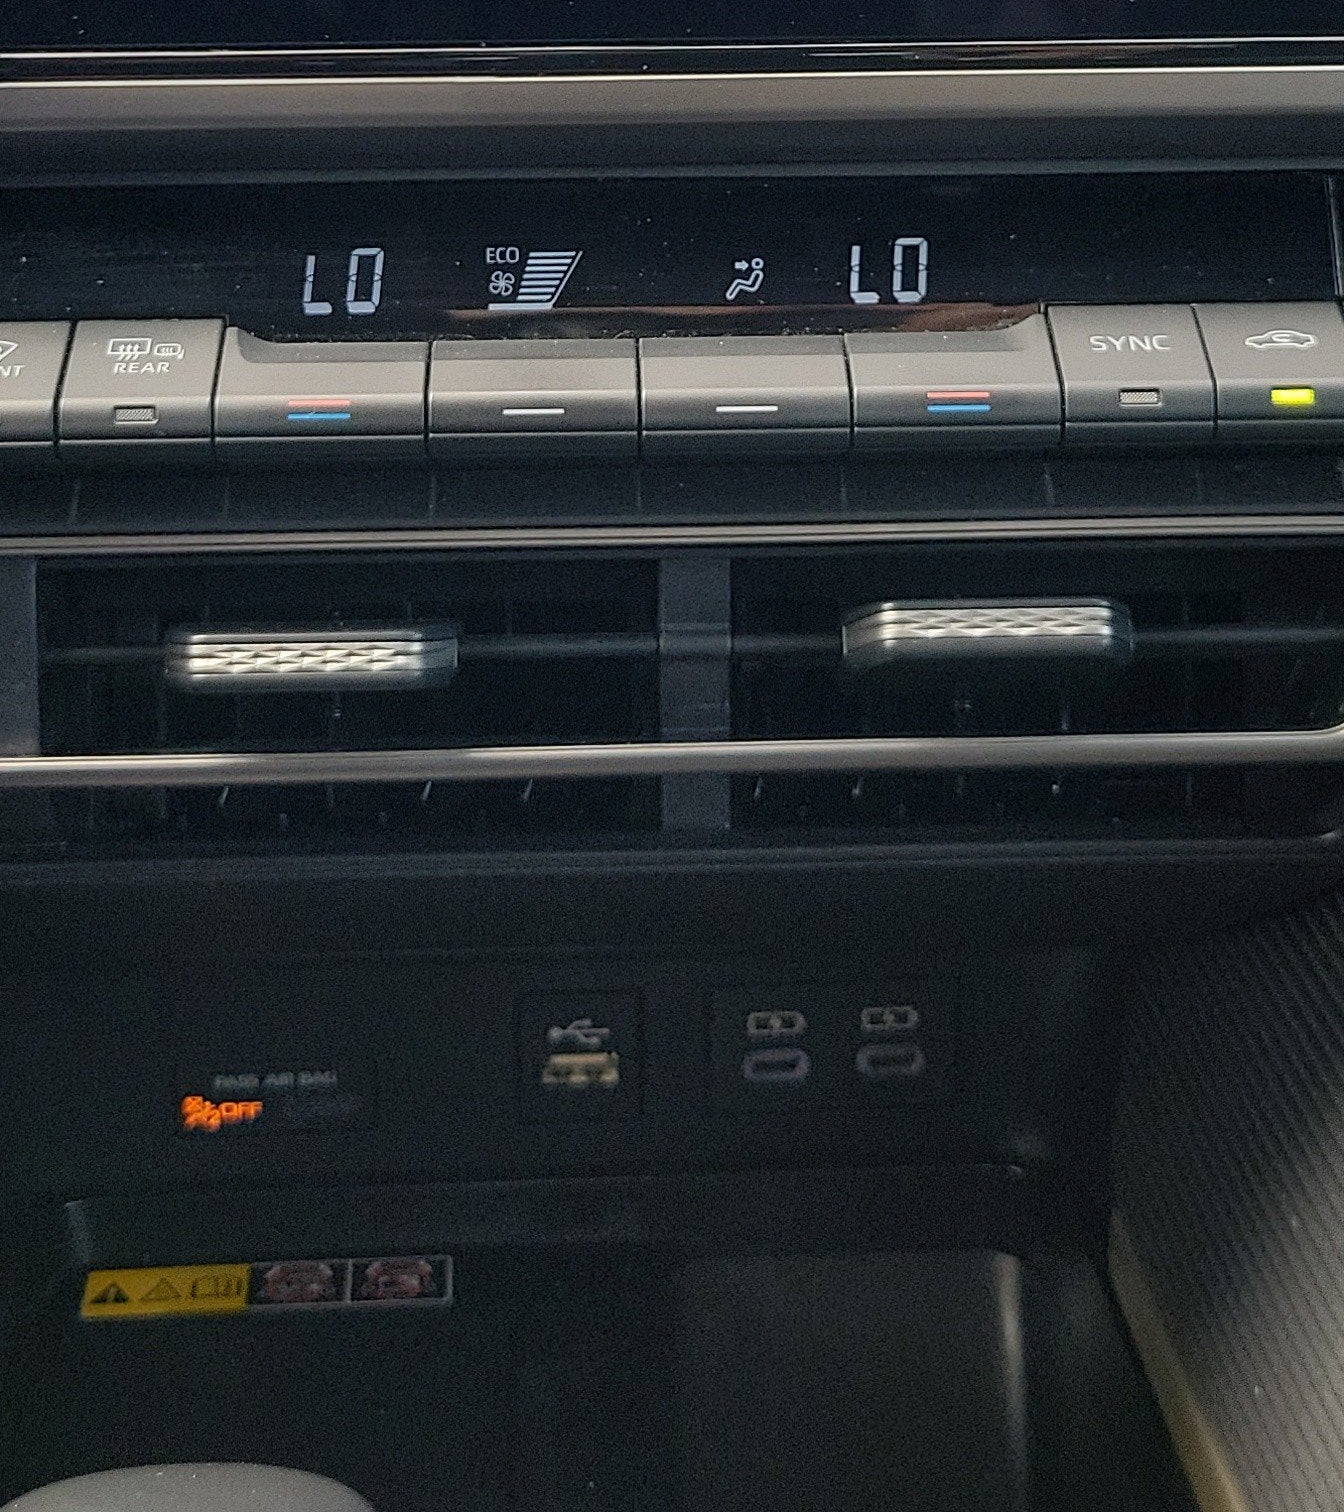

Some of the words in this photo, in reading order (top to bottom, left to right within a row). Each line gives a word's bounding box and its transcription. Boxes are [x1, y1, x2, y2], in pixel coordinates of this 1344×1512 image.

[486, 247, 519, 263] ECO
[850, 238, 927, 304] LO
[303, 248, 384, 315] LO
[1090, 336, 1170, 351] SYNC
[114, 362, 169, 373] REAR
[219, 1101, 263, 1122] OFF
